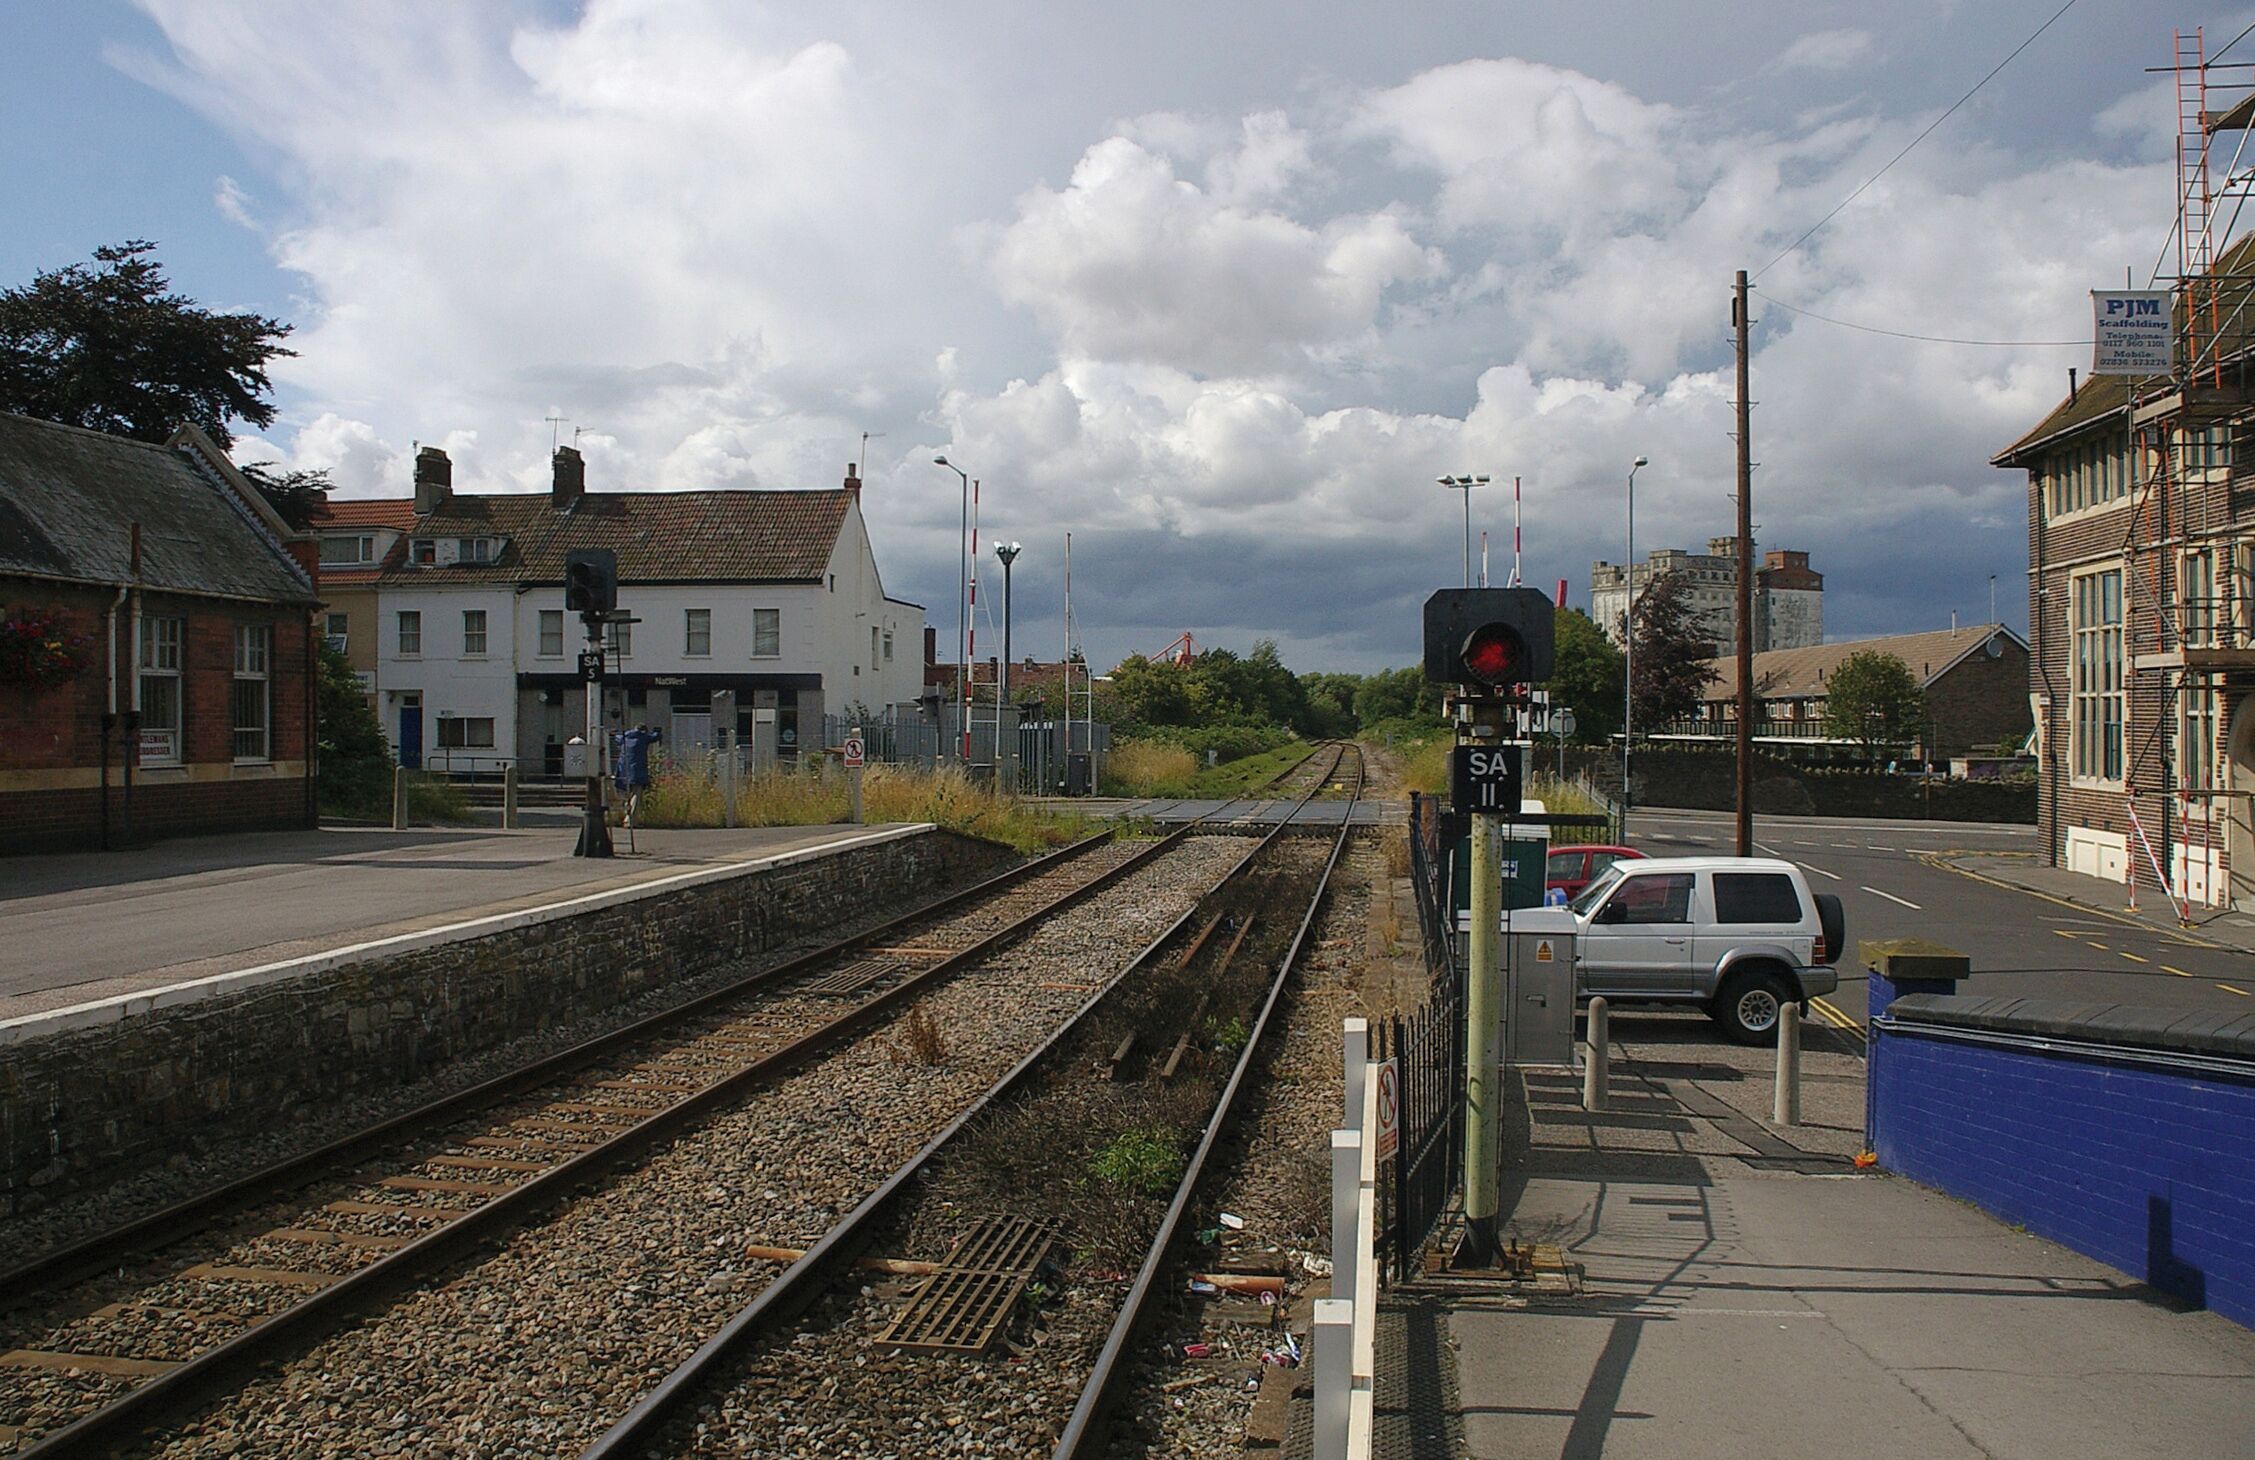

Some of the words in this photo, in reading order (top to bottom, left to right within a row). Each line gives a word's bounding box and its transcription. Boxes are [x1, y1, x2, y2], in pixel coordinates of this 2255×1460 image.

[2106, 299, 2160, 317] PJM
[2098, 319, 2168, 329] Scaffolding
[584, 656, 600, 666] SA
[1469, 752, 1509, 776] SA
